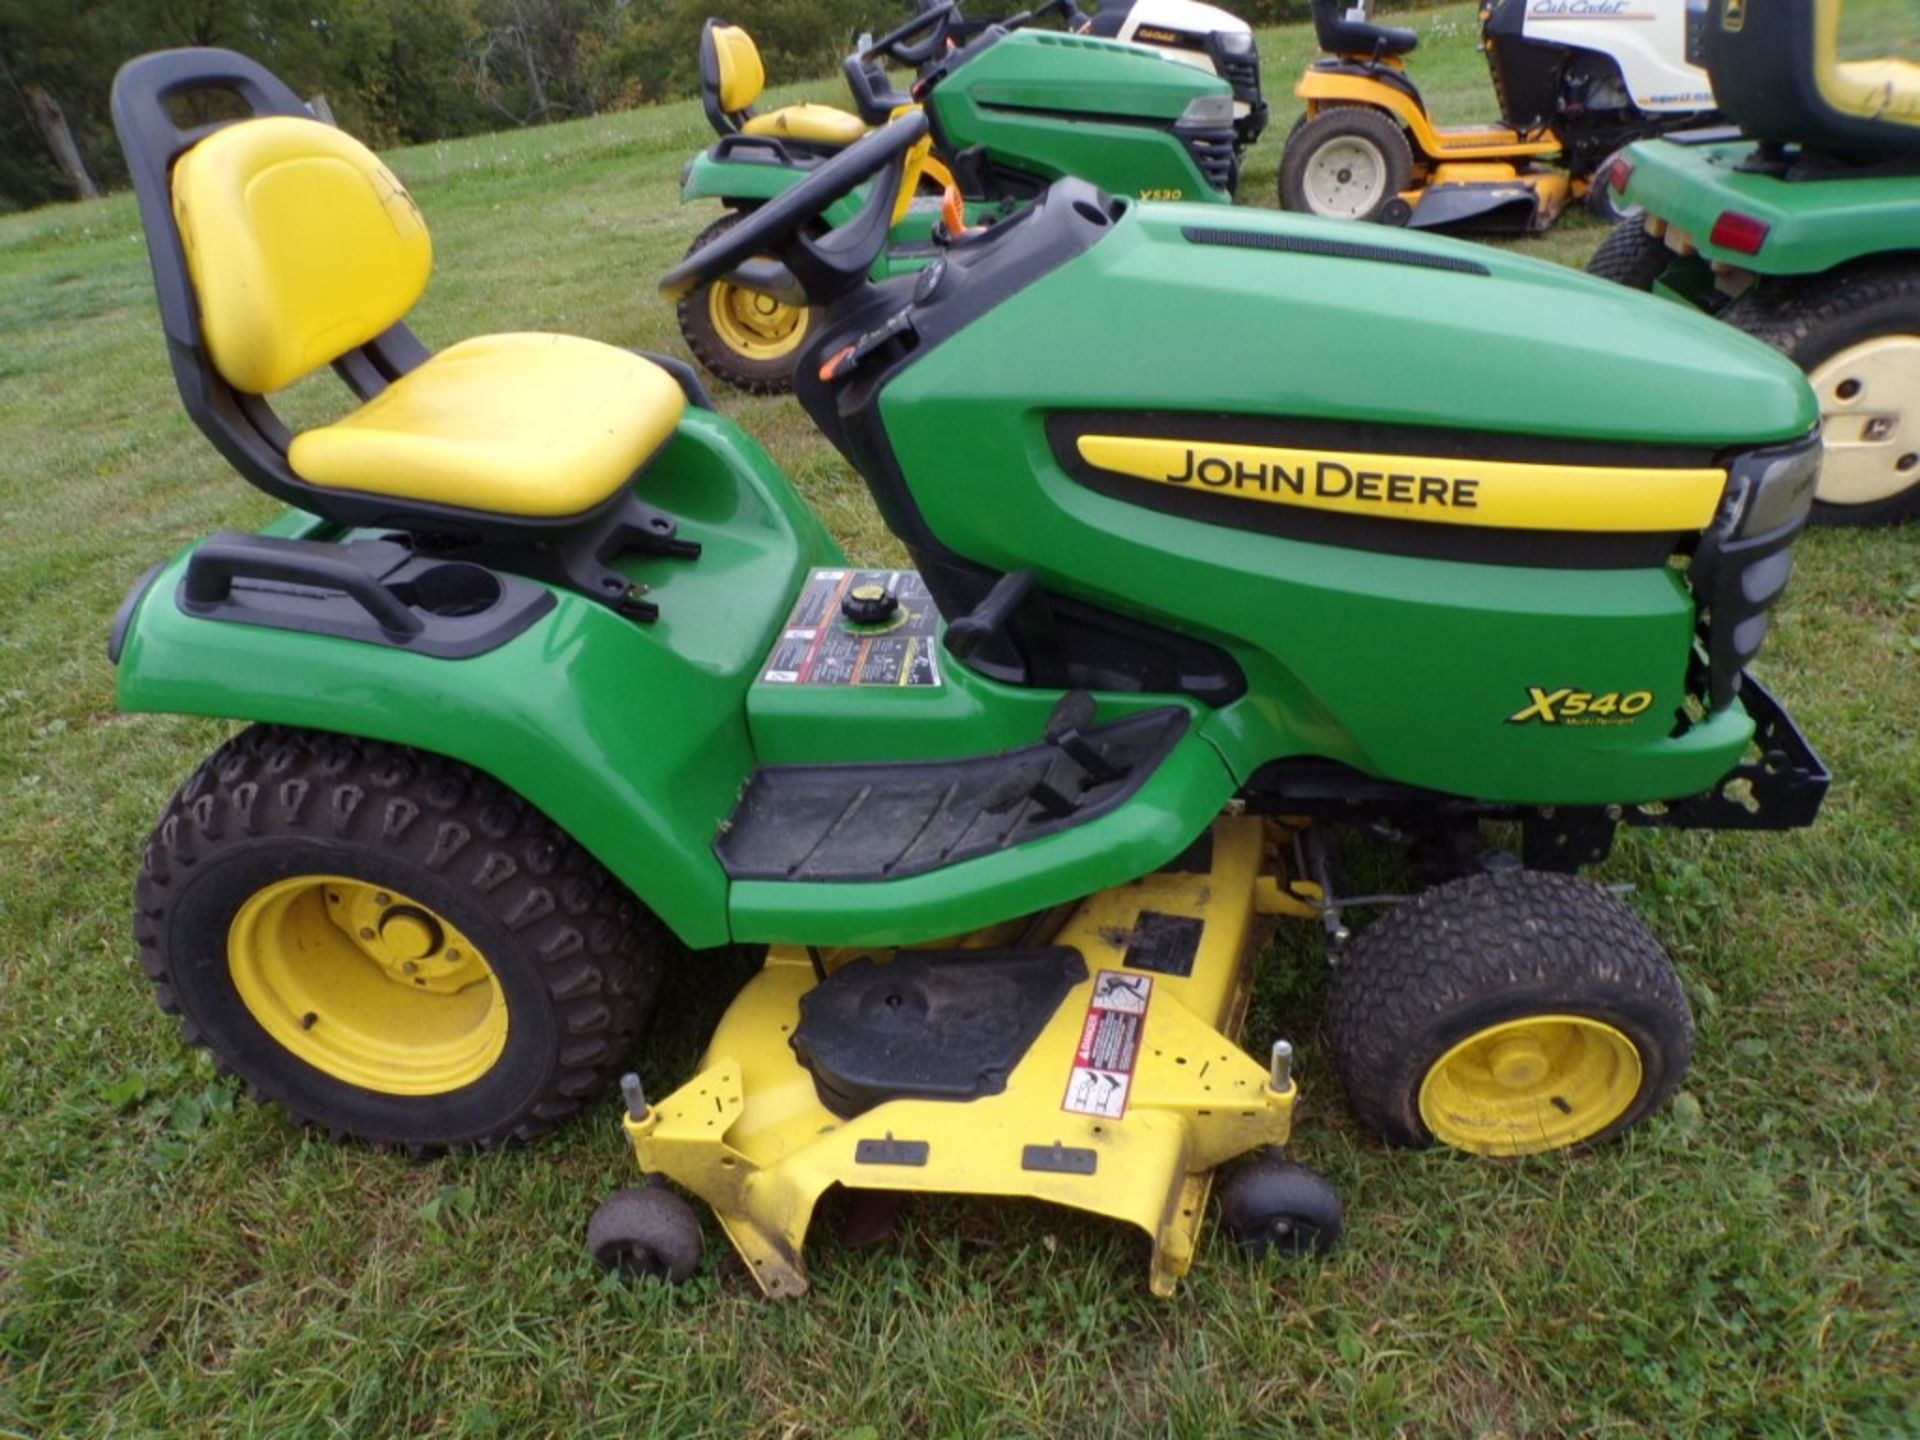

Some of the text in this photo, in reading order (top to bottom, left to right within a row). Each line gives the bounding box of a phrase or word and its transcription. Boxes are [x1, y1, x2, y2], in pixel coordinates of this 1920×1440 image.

[1533, 0, 1628, 14] Cub Cadet
[1166, 449, 1480, 508] JOHN DEERE
[1508, 687, 1653, 722] X540
